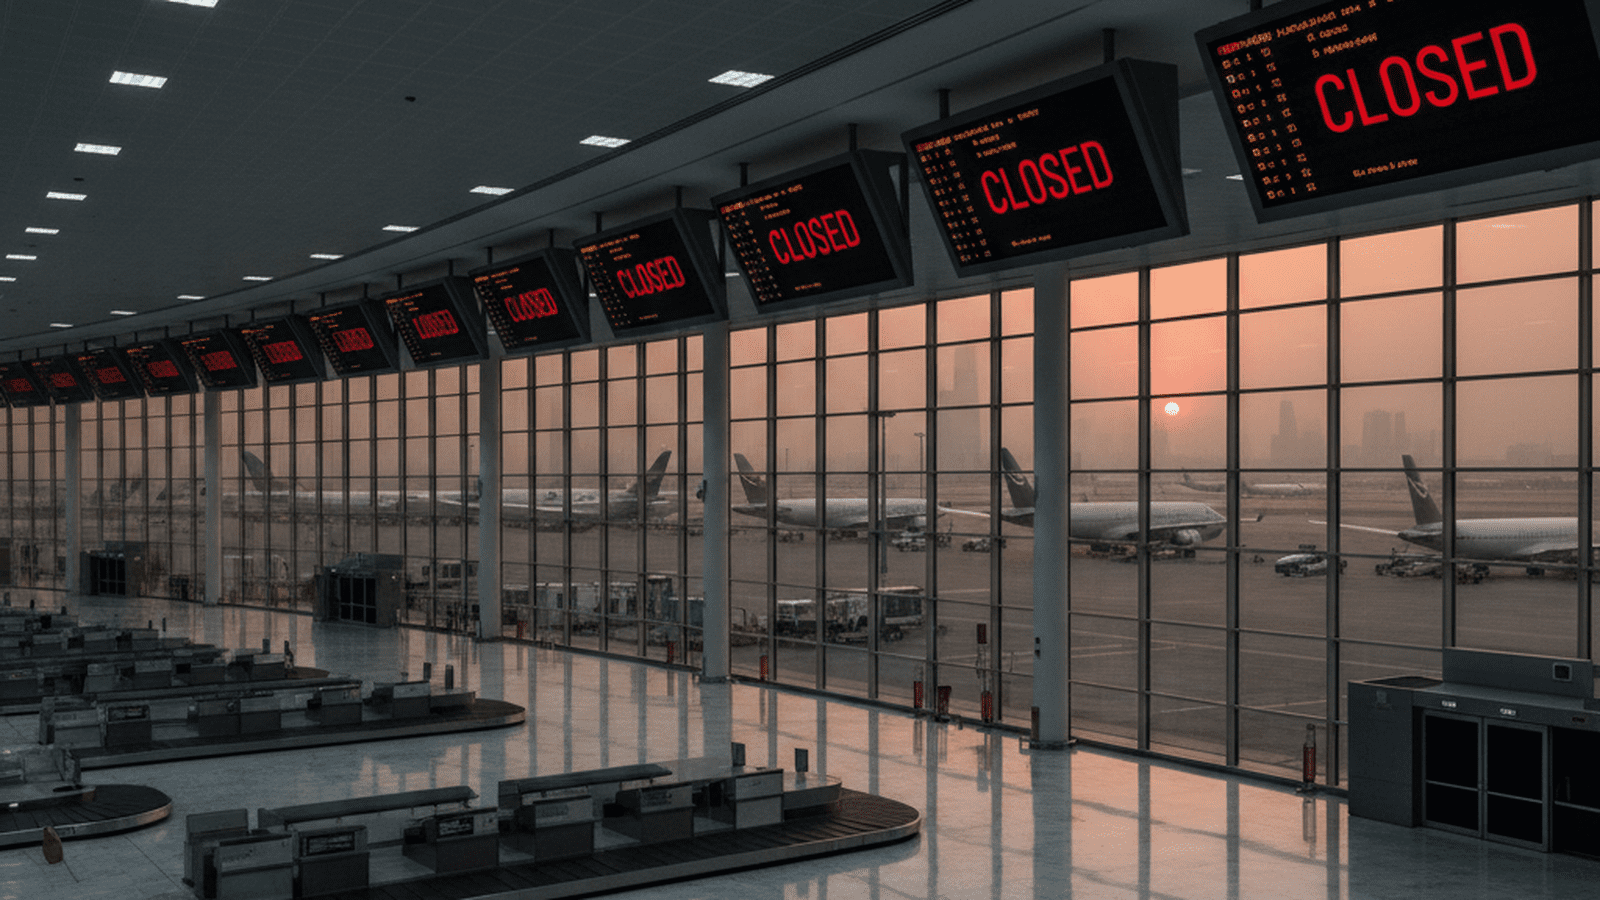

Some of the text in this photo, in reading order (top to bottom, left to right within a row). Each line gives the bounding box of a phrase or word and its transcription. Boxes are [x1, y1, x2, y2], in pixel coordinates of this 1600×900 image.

[1314, 22, 1538, 133] CLOSED
[980, 140, 1114, 215] CLOSED
[768, 209, 861, 265] CLOSED
[504, 287, 559, 323] CLOSED
[616, 255, 686, 299] CLOSED
